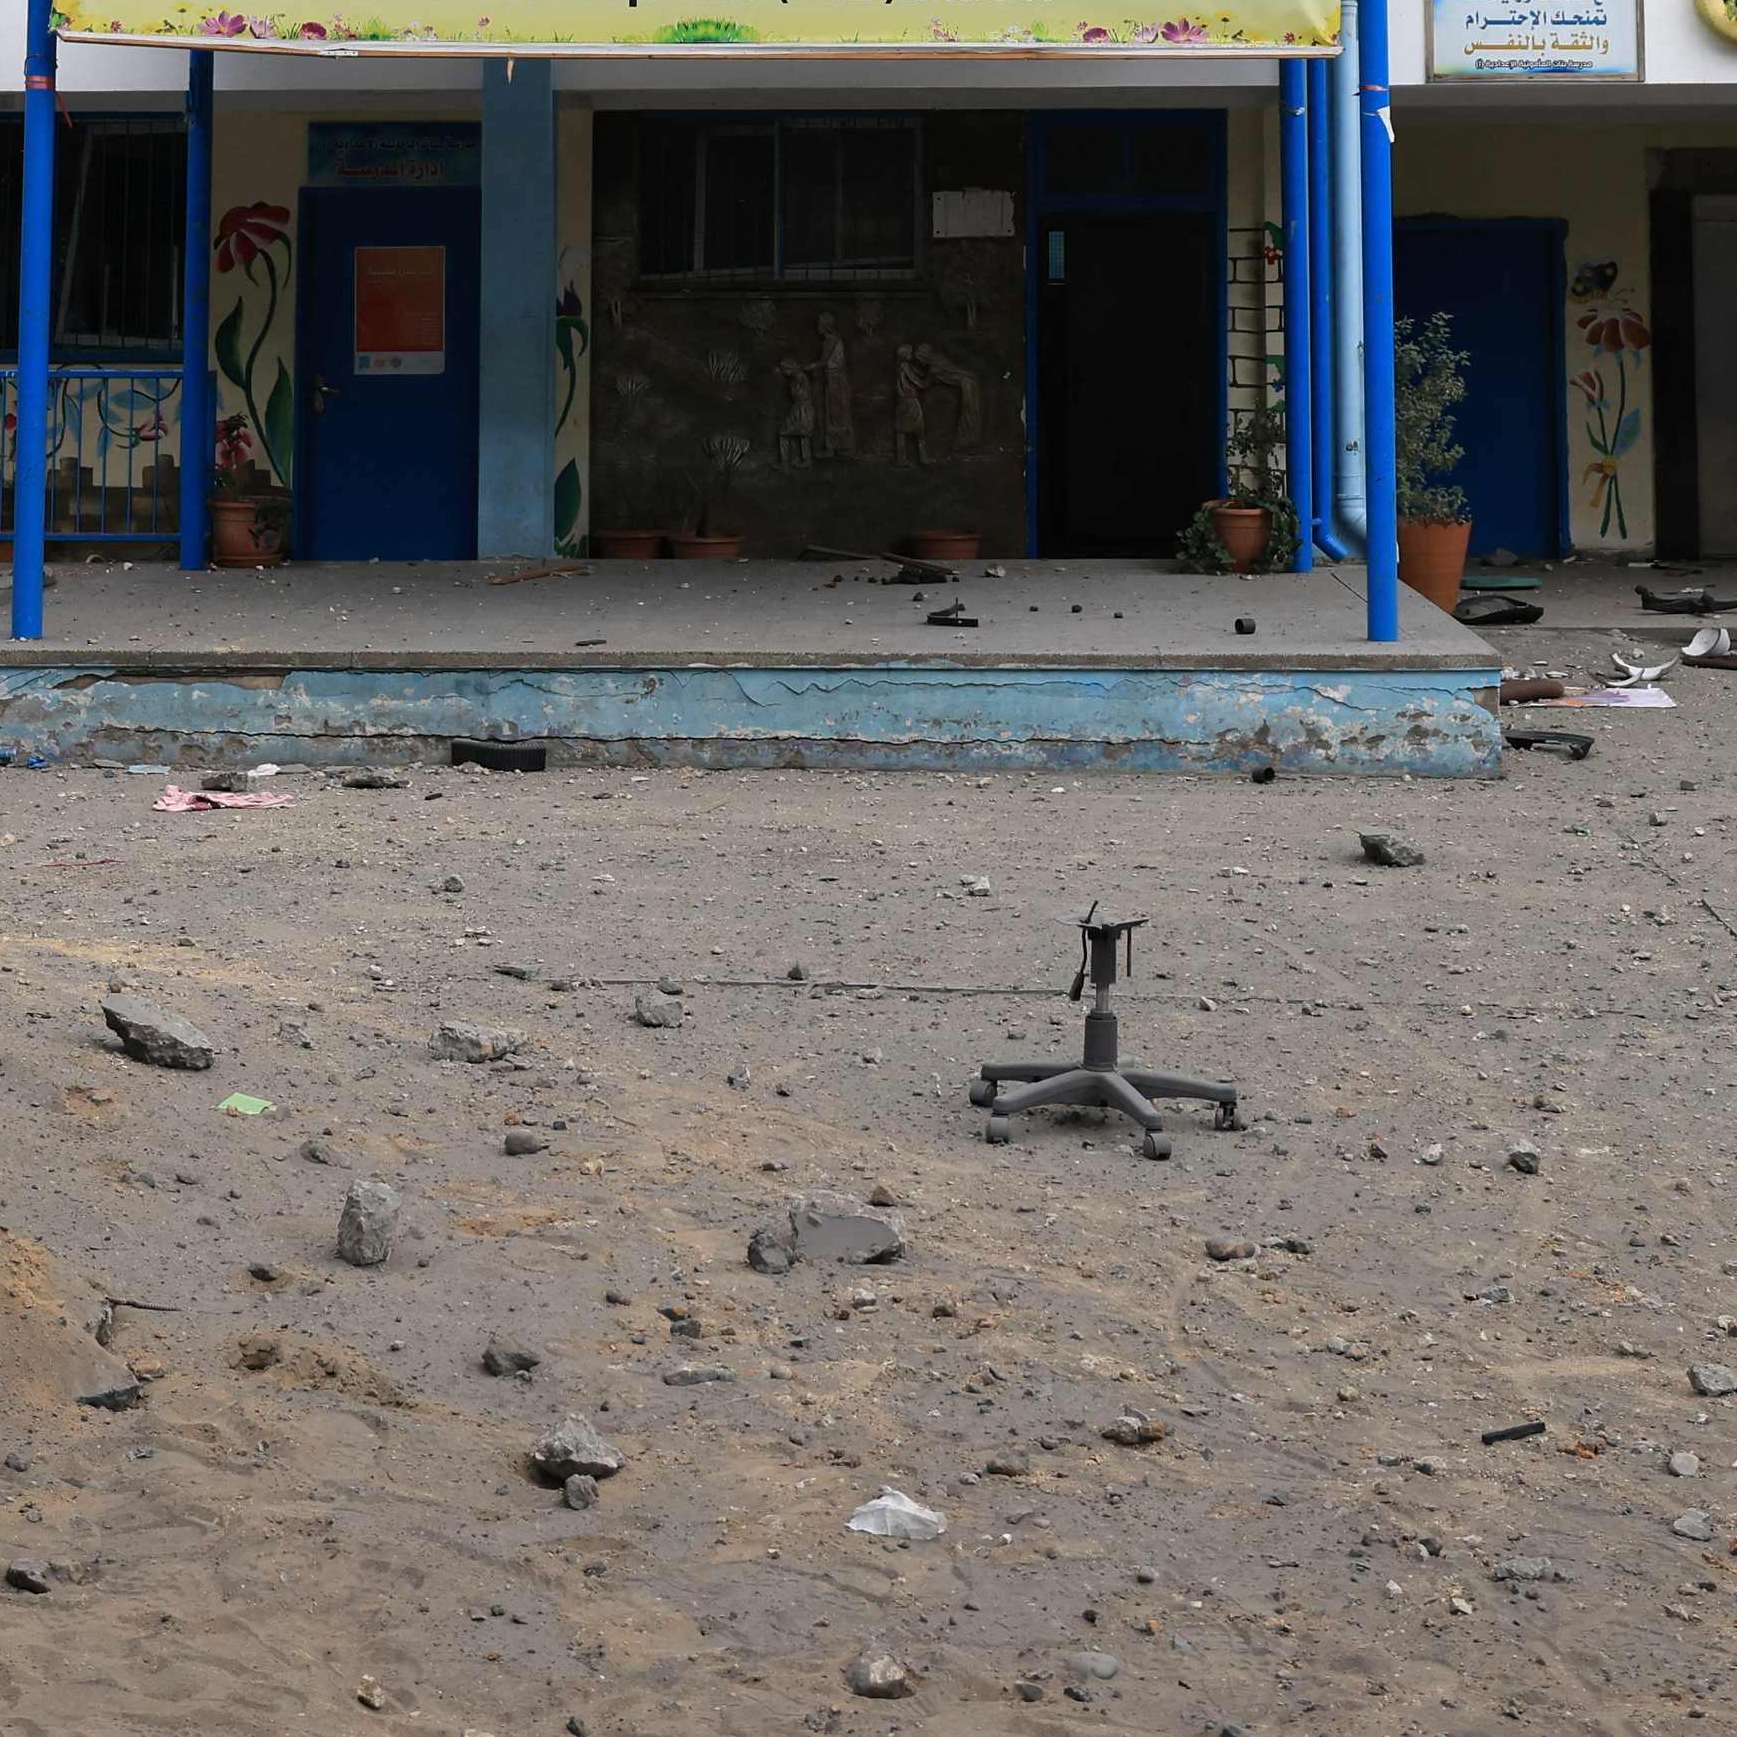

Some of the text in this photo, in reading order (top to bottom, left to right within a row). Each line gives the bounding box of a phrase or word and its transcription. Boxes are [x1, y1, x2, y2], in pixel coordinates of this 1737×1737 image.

[1465, 8, 1608, 31] تمنحك الإحترام
[1463, 31, 1610, 57] والثقة بالنفس
